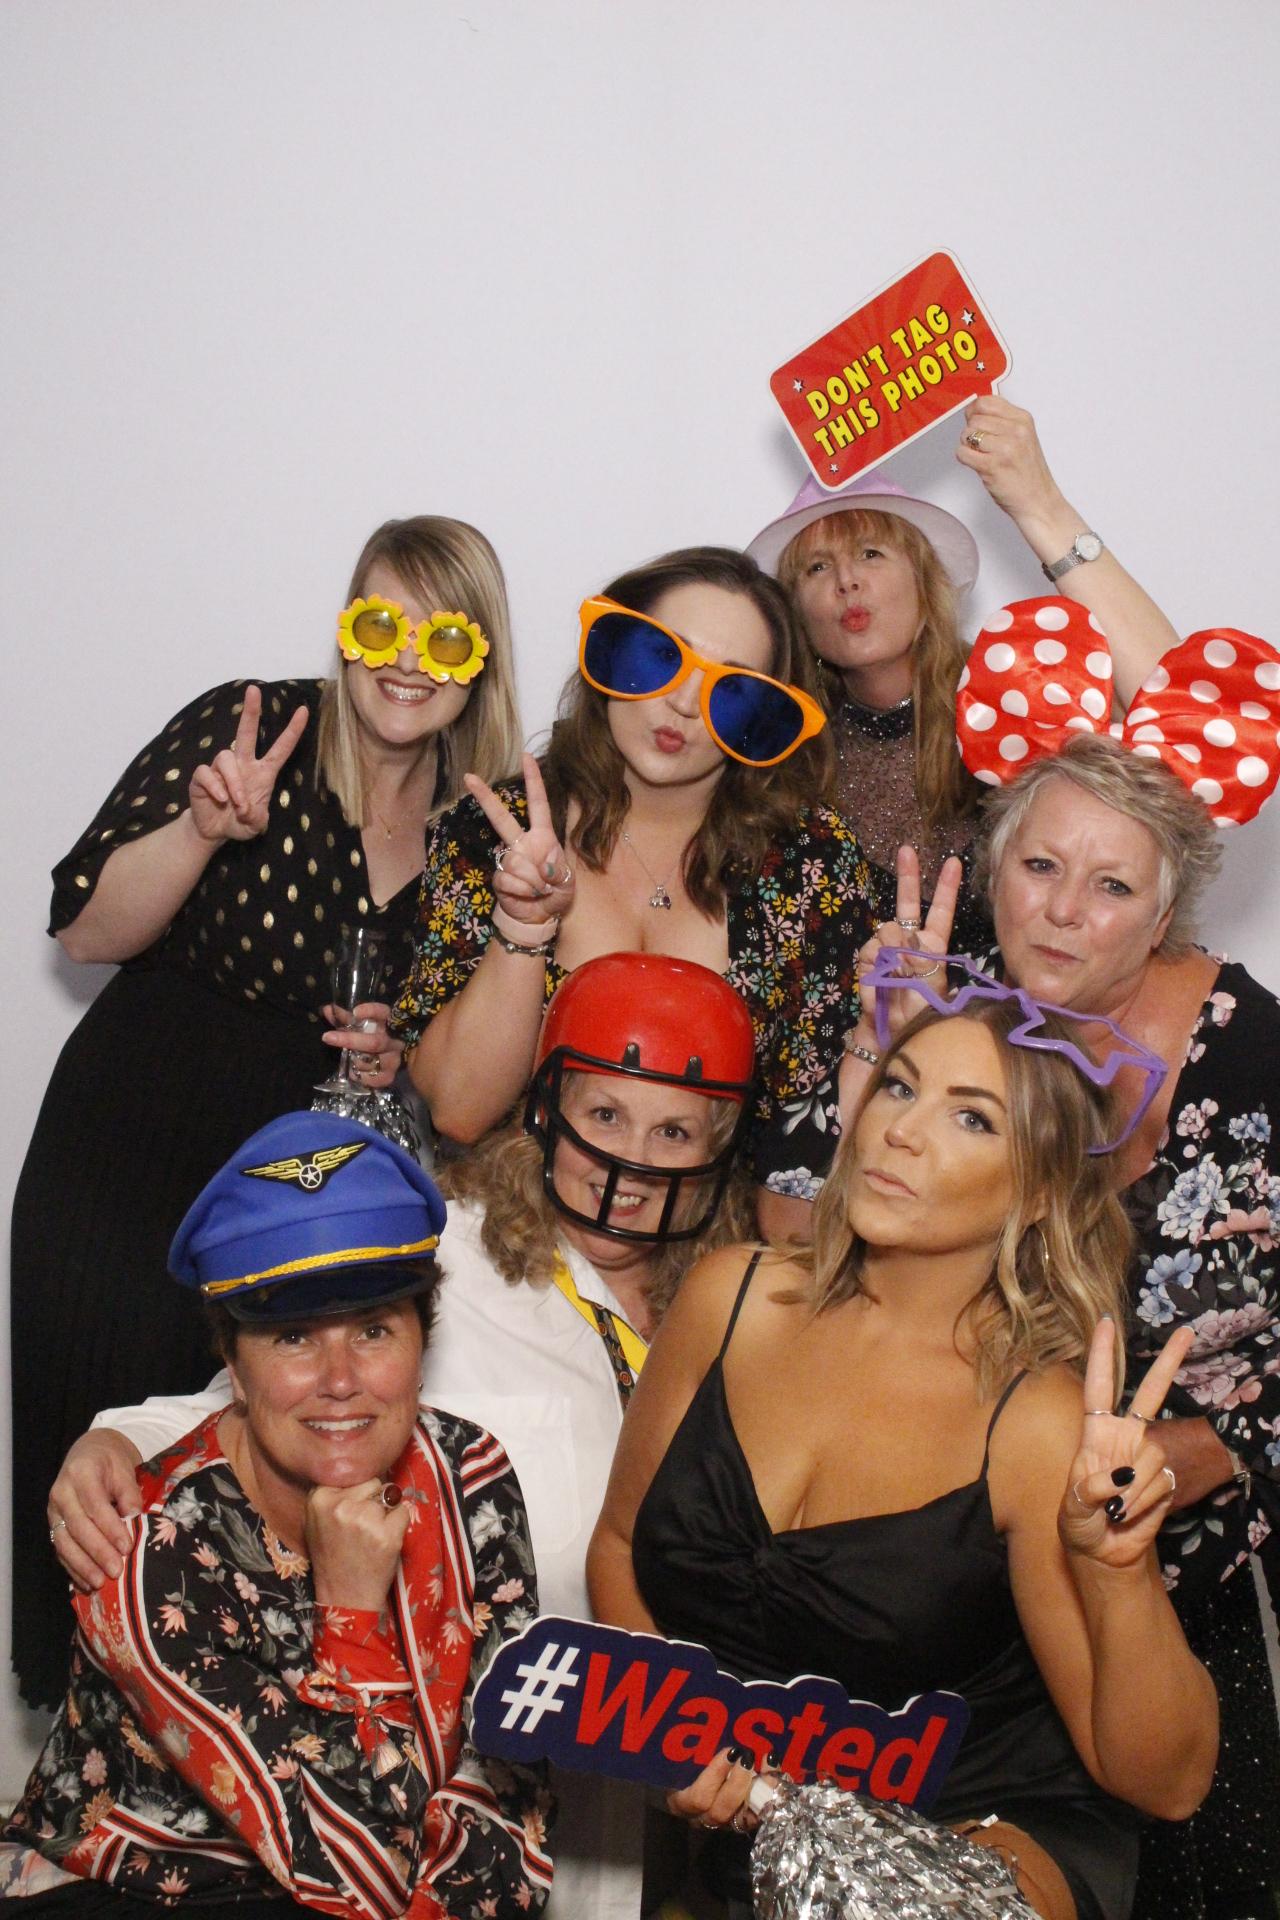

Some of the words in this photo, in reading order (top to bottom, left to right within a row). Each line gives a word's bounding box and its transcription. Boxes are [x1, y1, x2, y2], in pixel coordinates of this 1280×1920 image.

[806, 345, 890, 421] DON'T
[890, 304, 950, 359] TAG
[813, 398, 880, 457] THIS
[880, 330, 978, 412] PHOTO
[499, 1642, 949, 1805] #Wasted
